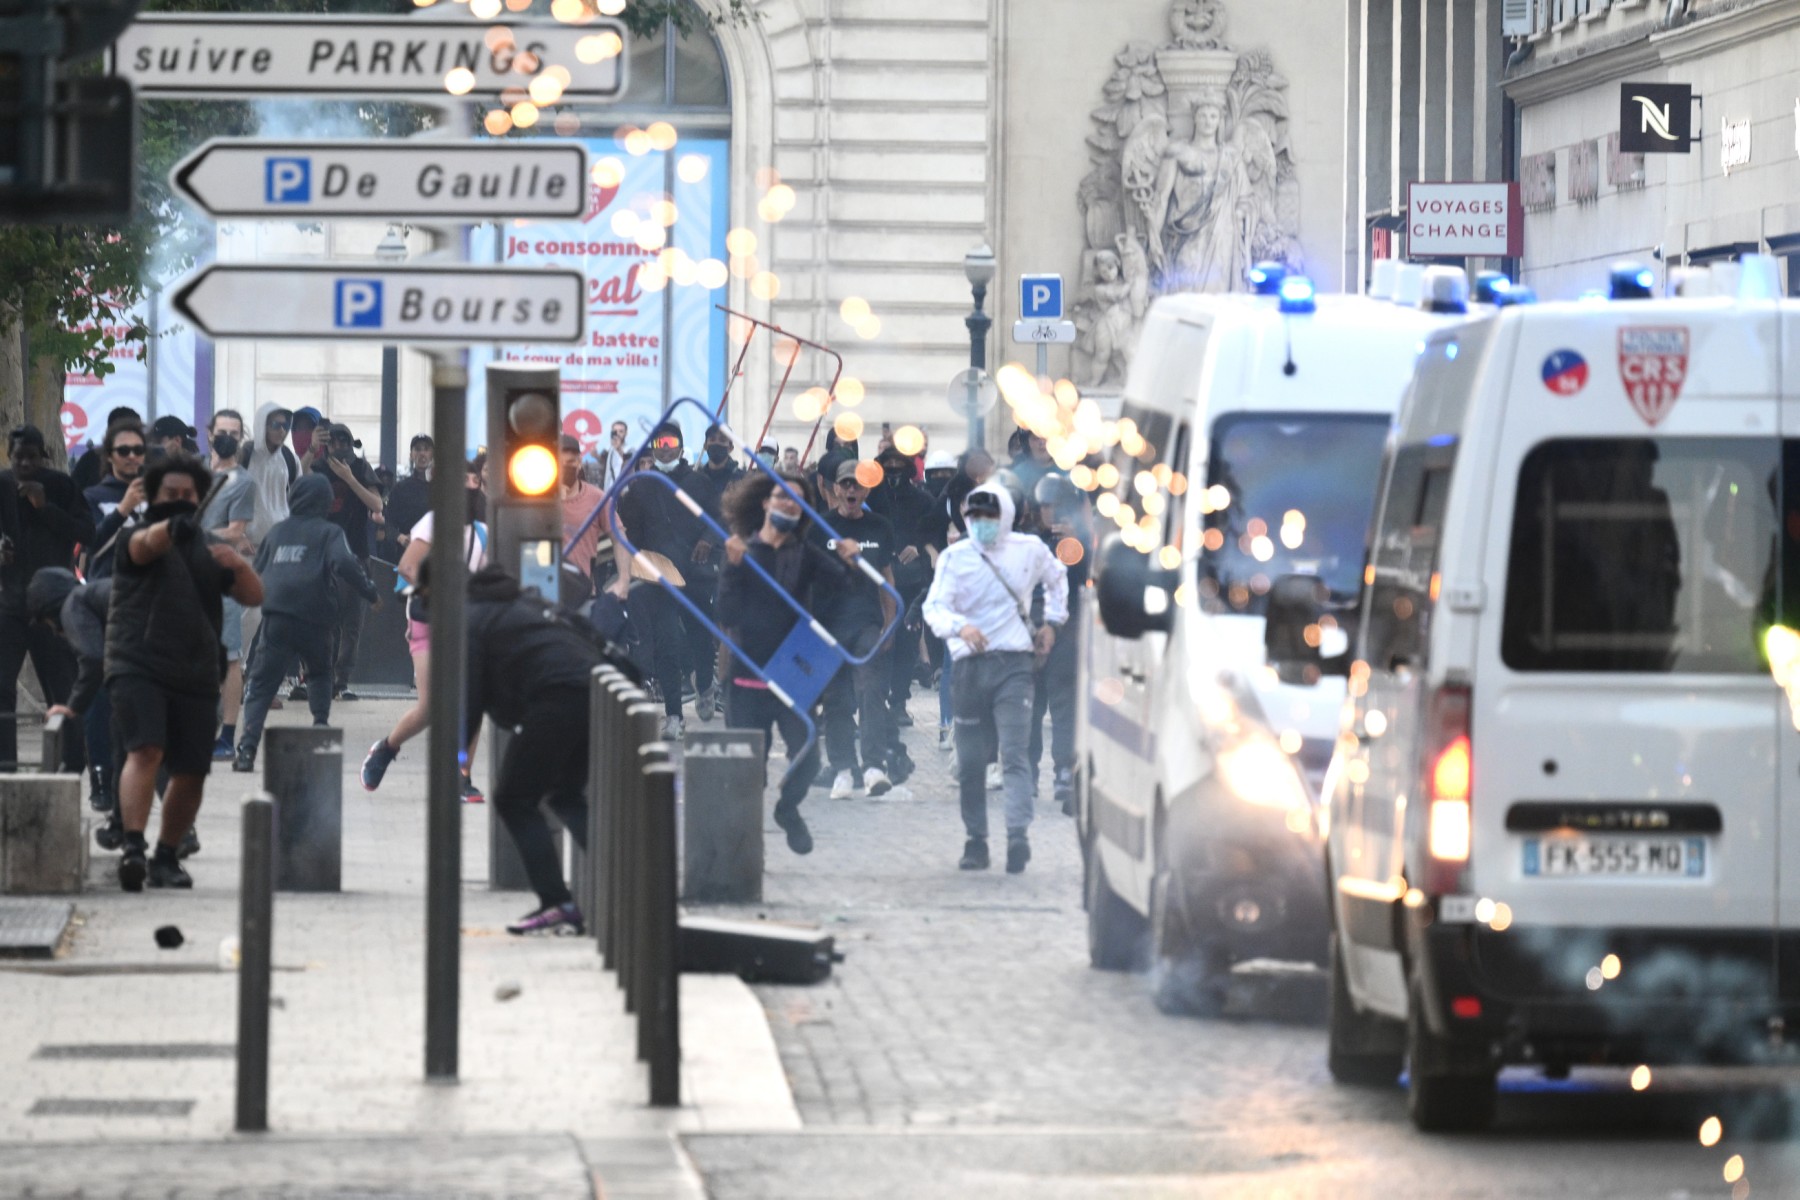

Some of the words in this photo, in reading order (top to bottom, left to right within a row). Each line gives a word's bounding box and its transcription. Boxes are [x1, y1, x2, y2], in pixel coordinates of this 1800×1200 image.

[133, 38, 273, 73] suivre
[307, 39, 548, 75] PARKINGS
[271, 161, 304, 201] P
[321, 163, 378, 199] De
[416, 163, 567, 199] Gaulle
[1416, 200, 1504, 214] VOYAGES
[1413, 223, 1506, 238] CHANGE
[507, 236, 529, 259] Je
[341, 282, 376, 326] P
[399, 287, 563, 323] Bourse
[1032, 284, 1051, 312] P
[592, 331, 660, 348] battre
[565, 353, 583, 366] de
[587, 356, 612, 366] ma
[616, 353, 650, 366] ville
[1623, 355, 1684, 383] CRS
